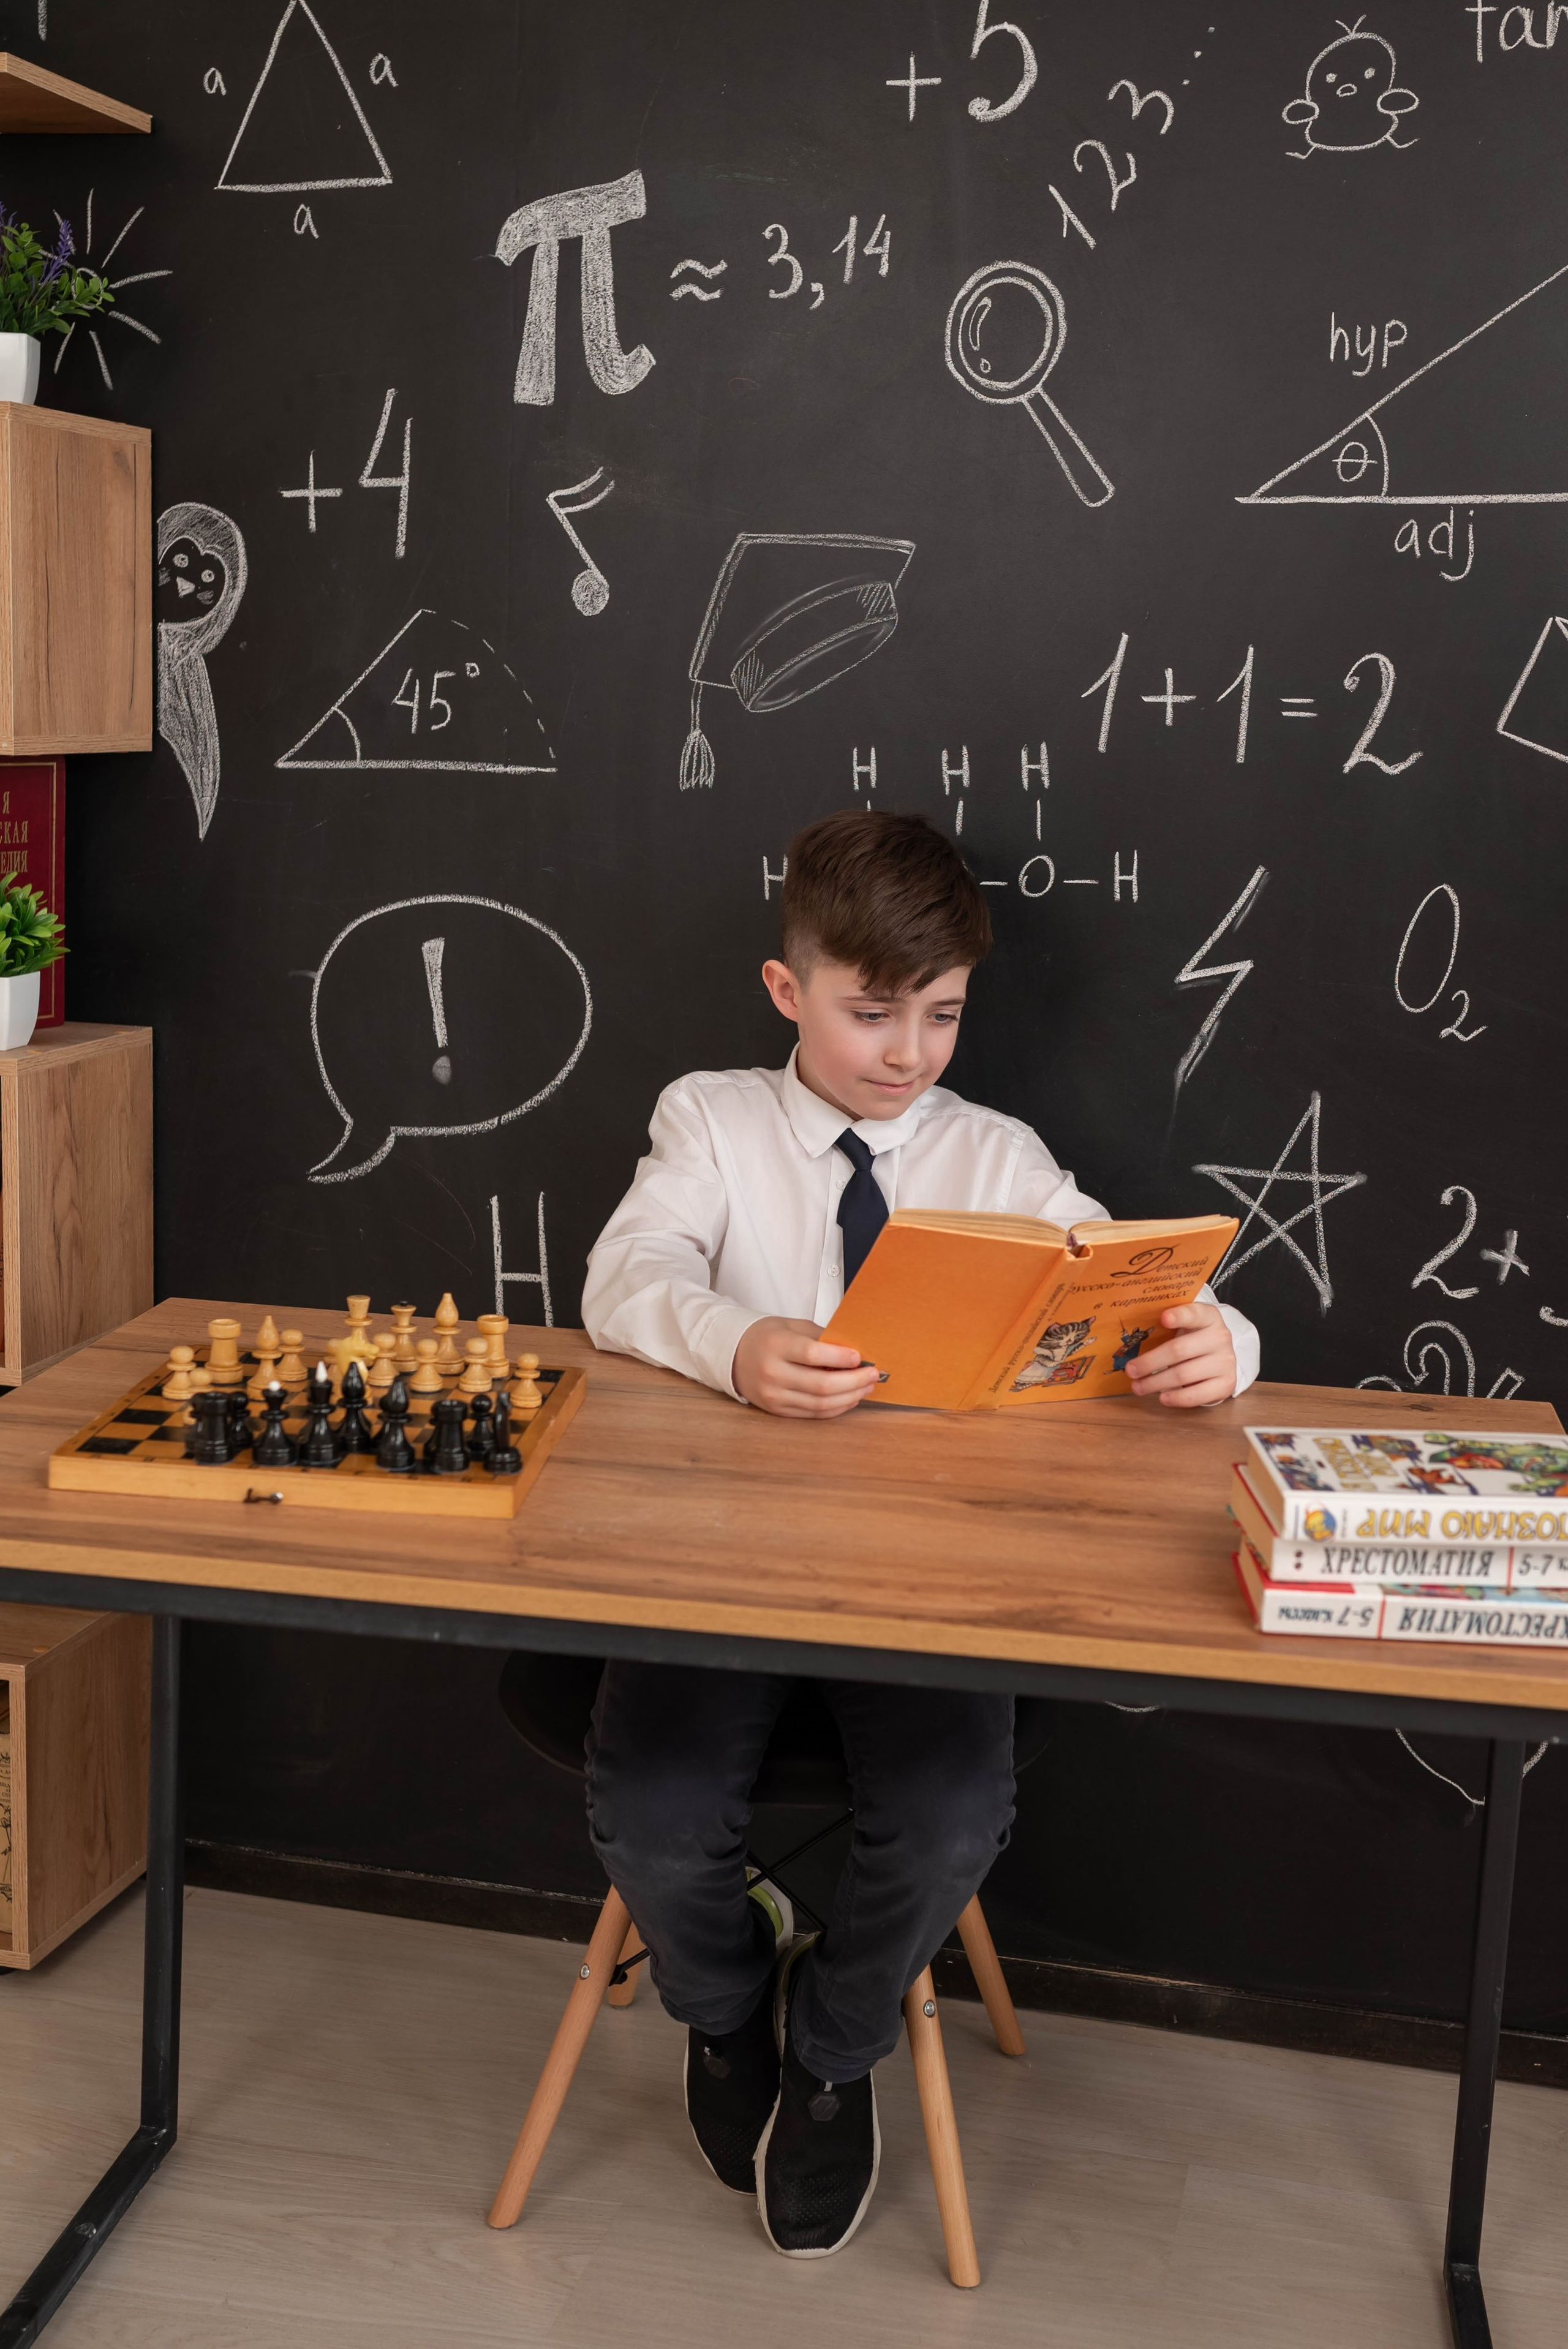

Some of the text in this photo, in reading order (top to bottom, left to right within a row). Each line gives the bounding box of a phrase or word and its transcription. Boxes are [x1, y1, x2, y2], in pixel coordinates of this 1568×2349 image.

[203, 67, 226, 95] a
[369, 53, 398, 87] a
[293, 204, 319, 238] a
[762, 214, 891, 310] 3,14
[1330, 312, 1408, 377] hyp
[1394, 506, 1474, 581] adj
[853, 741, 1050, 795] H H H
[1110, 1243, 1209, 1278] Детский
[1109, 1289, 1190, 1308] картинках
[1142, 1280, 1195, 1295] словарь
[1356, 1508, 1431, 1538] МИР
[1321, 1547, 1495, 1578] ХРЕСТОМАТИЯ
